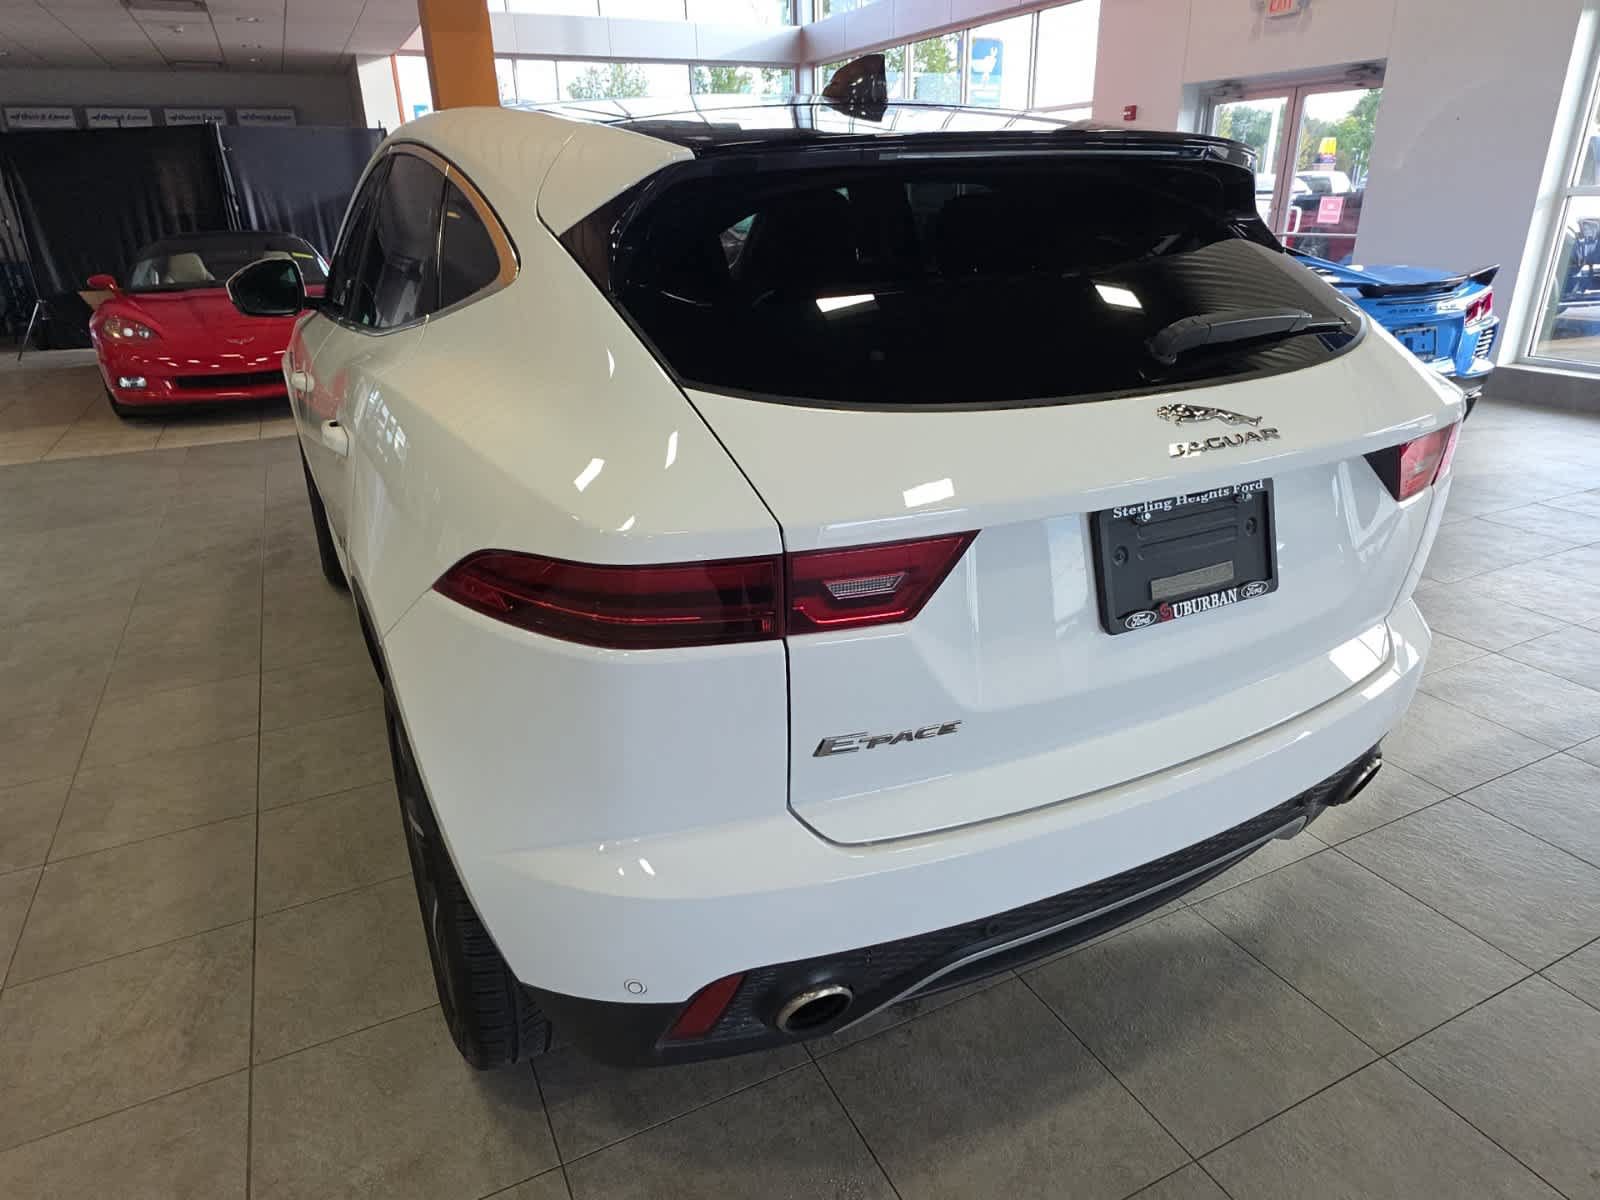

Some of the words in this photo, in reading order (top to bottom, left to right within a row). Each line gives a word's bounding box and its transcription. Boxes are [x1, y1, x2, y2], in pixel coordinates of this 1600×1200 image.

[1169, 427, 1280, 458] JAGUAR
[1113, 499, 1173, 519] Sterling
[1176, 487, 1230, 506] Heights
[1233, 480, 1264, 495] Ford
[1159, 588, 1238, 622] SUBURBAN
